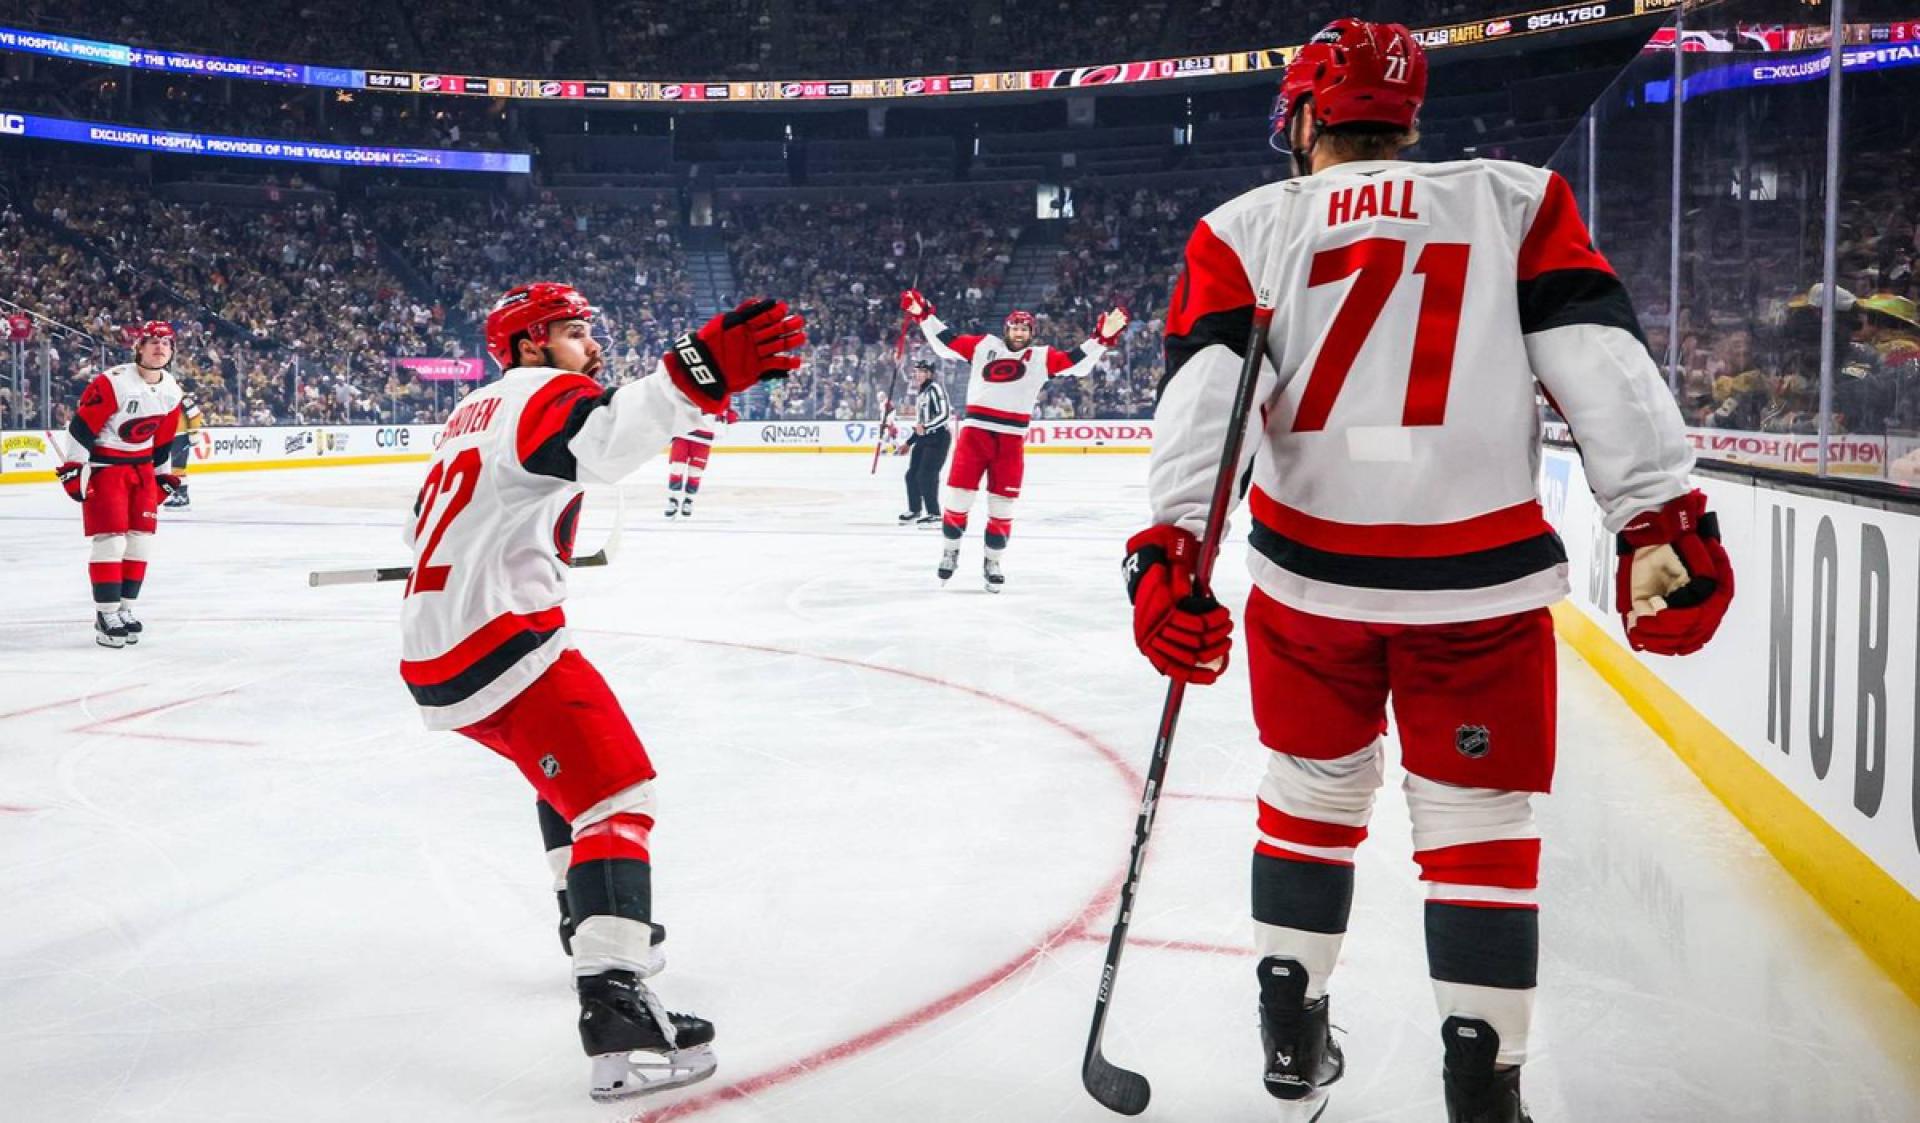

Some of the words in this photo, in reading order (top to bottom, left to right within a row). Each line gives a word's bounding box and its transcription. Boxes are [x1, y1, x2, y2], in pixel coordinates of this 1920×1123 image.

[1527, 5, 1606, 30] $54,760
[1449, 24, 1485, 43] RAFFLE
[18, 35, 71, 52] HOSPITAL
[72, 43, 125, 60] PROVIDER
[128, 52, 142, 63] OF
[144, 54, 165, 66] THE
[168, 57, 204, 70] VEGAS
[206, 60, 250, 74] GOLDEN
[1842, 45, 1920, 67] SPITAL
[1162, 62, 1174, 76] 0
[1384, 55, 1408, 84] 71
[394, 75, 410, 87] PM
[448, 79, 457, 91] 1
[805, 84, 826, 95] 0/0
[91, 127, 149, 145] EXCLUSIVE
[152, 134, 204, 150] HOSPITAL
[207, 139, 262, 154] PROVIDER
[265, 144, 281, 156] OF
[283, 145, 304, 157] THE
[307, 147, 341, 161] VEGAS
[344, 150, 389, 163] GOLDEN
[1327, 180, 1419, 227] HALL
[1290, 237, 1472, 433] 71
[376, 428, 409, 447] core
[1053, 426, 1153, 439] HONDA
[214, 434, 262, 455] paylocity
[404, 447, 483, 600] 22
[1768, 503, 1920, 856] NOB
